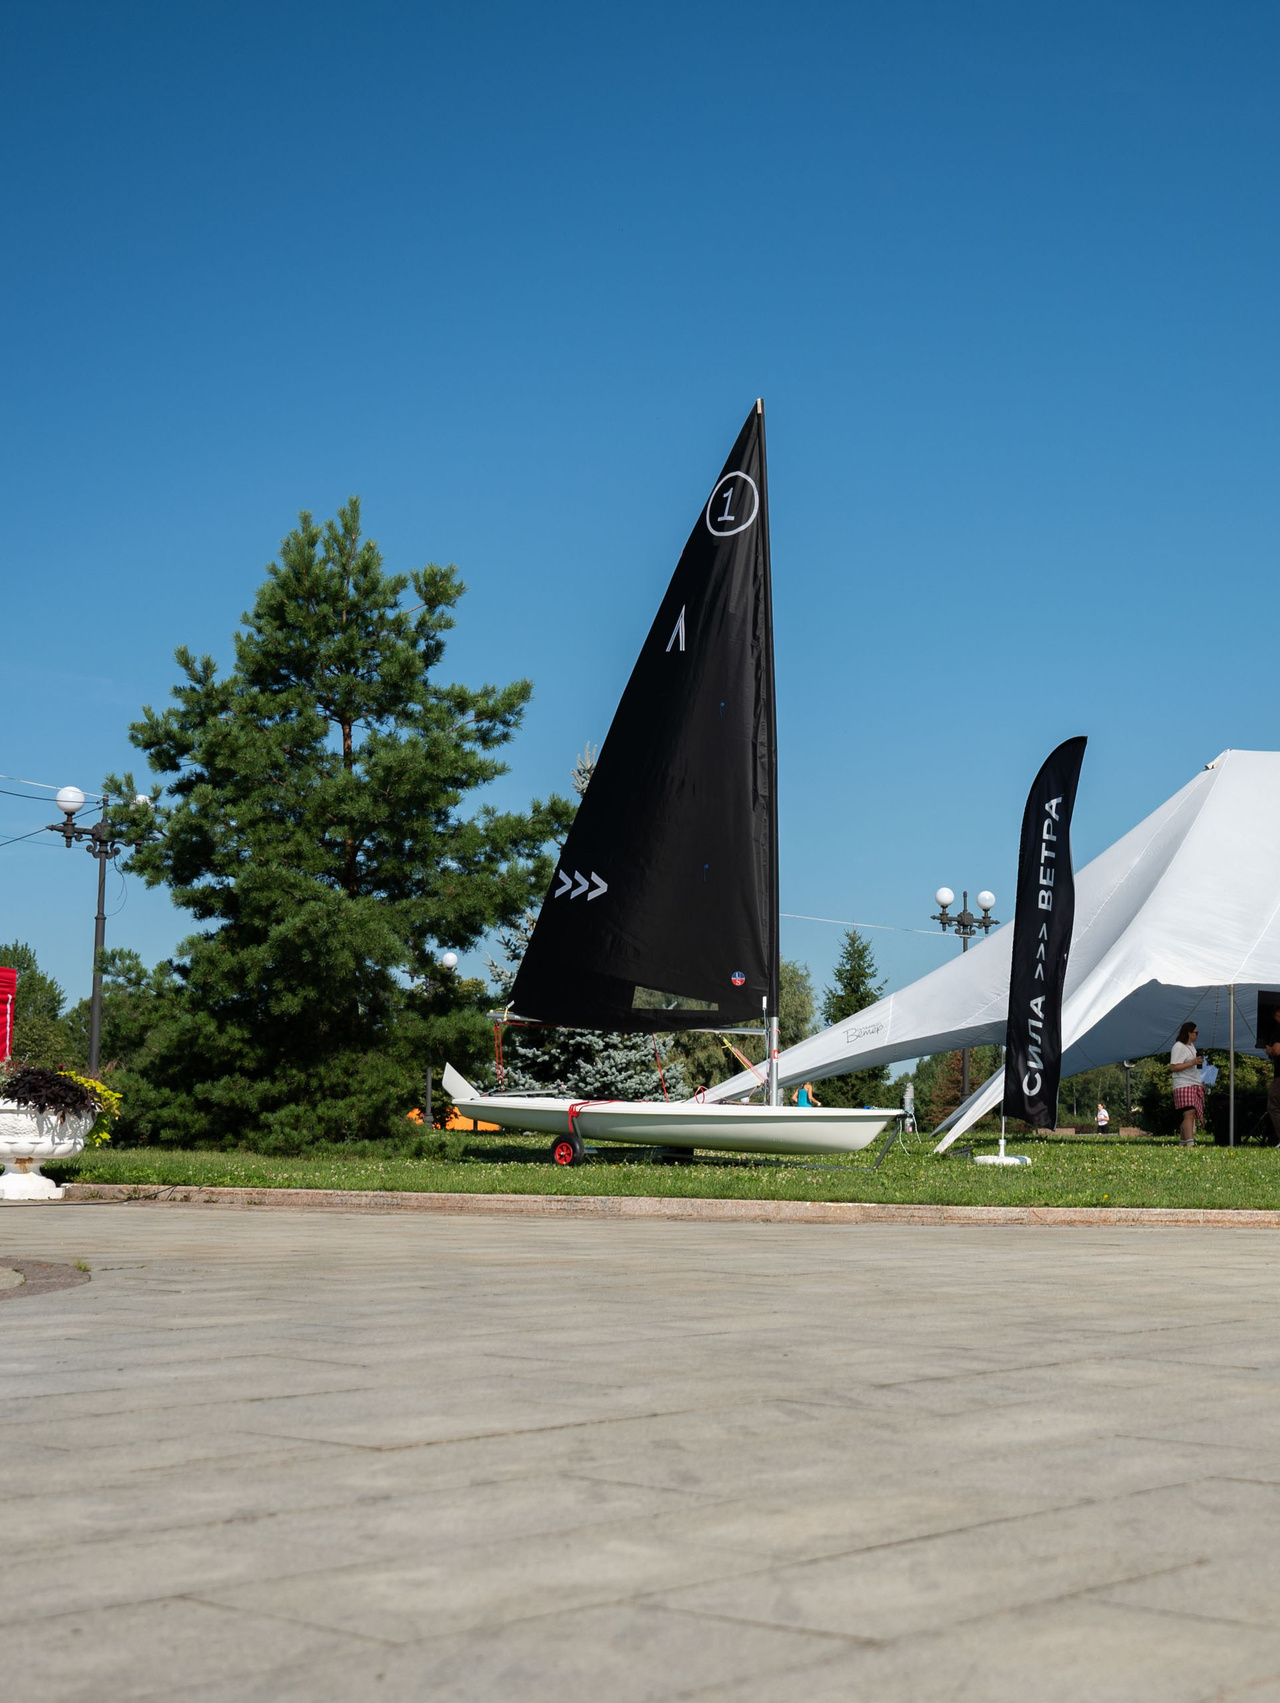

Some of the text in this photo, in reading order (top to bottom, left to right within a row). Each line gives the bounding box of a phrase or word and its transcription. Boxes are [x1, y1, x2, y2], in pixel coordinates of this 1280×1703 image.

[717, 486, 735, 522] 1
[1022, 796, 1062, 1096] СИЛА ВЕТРА
